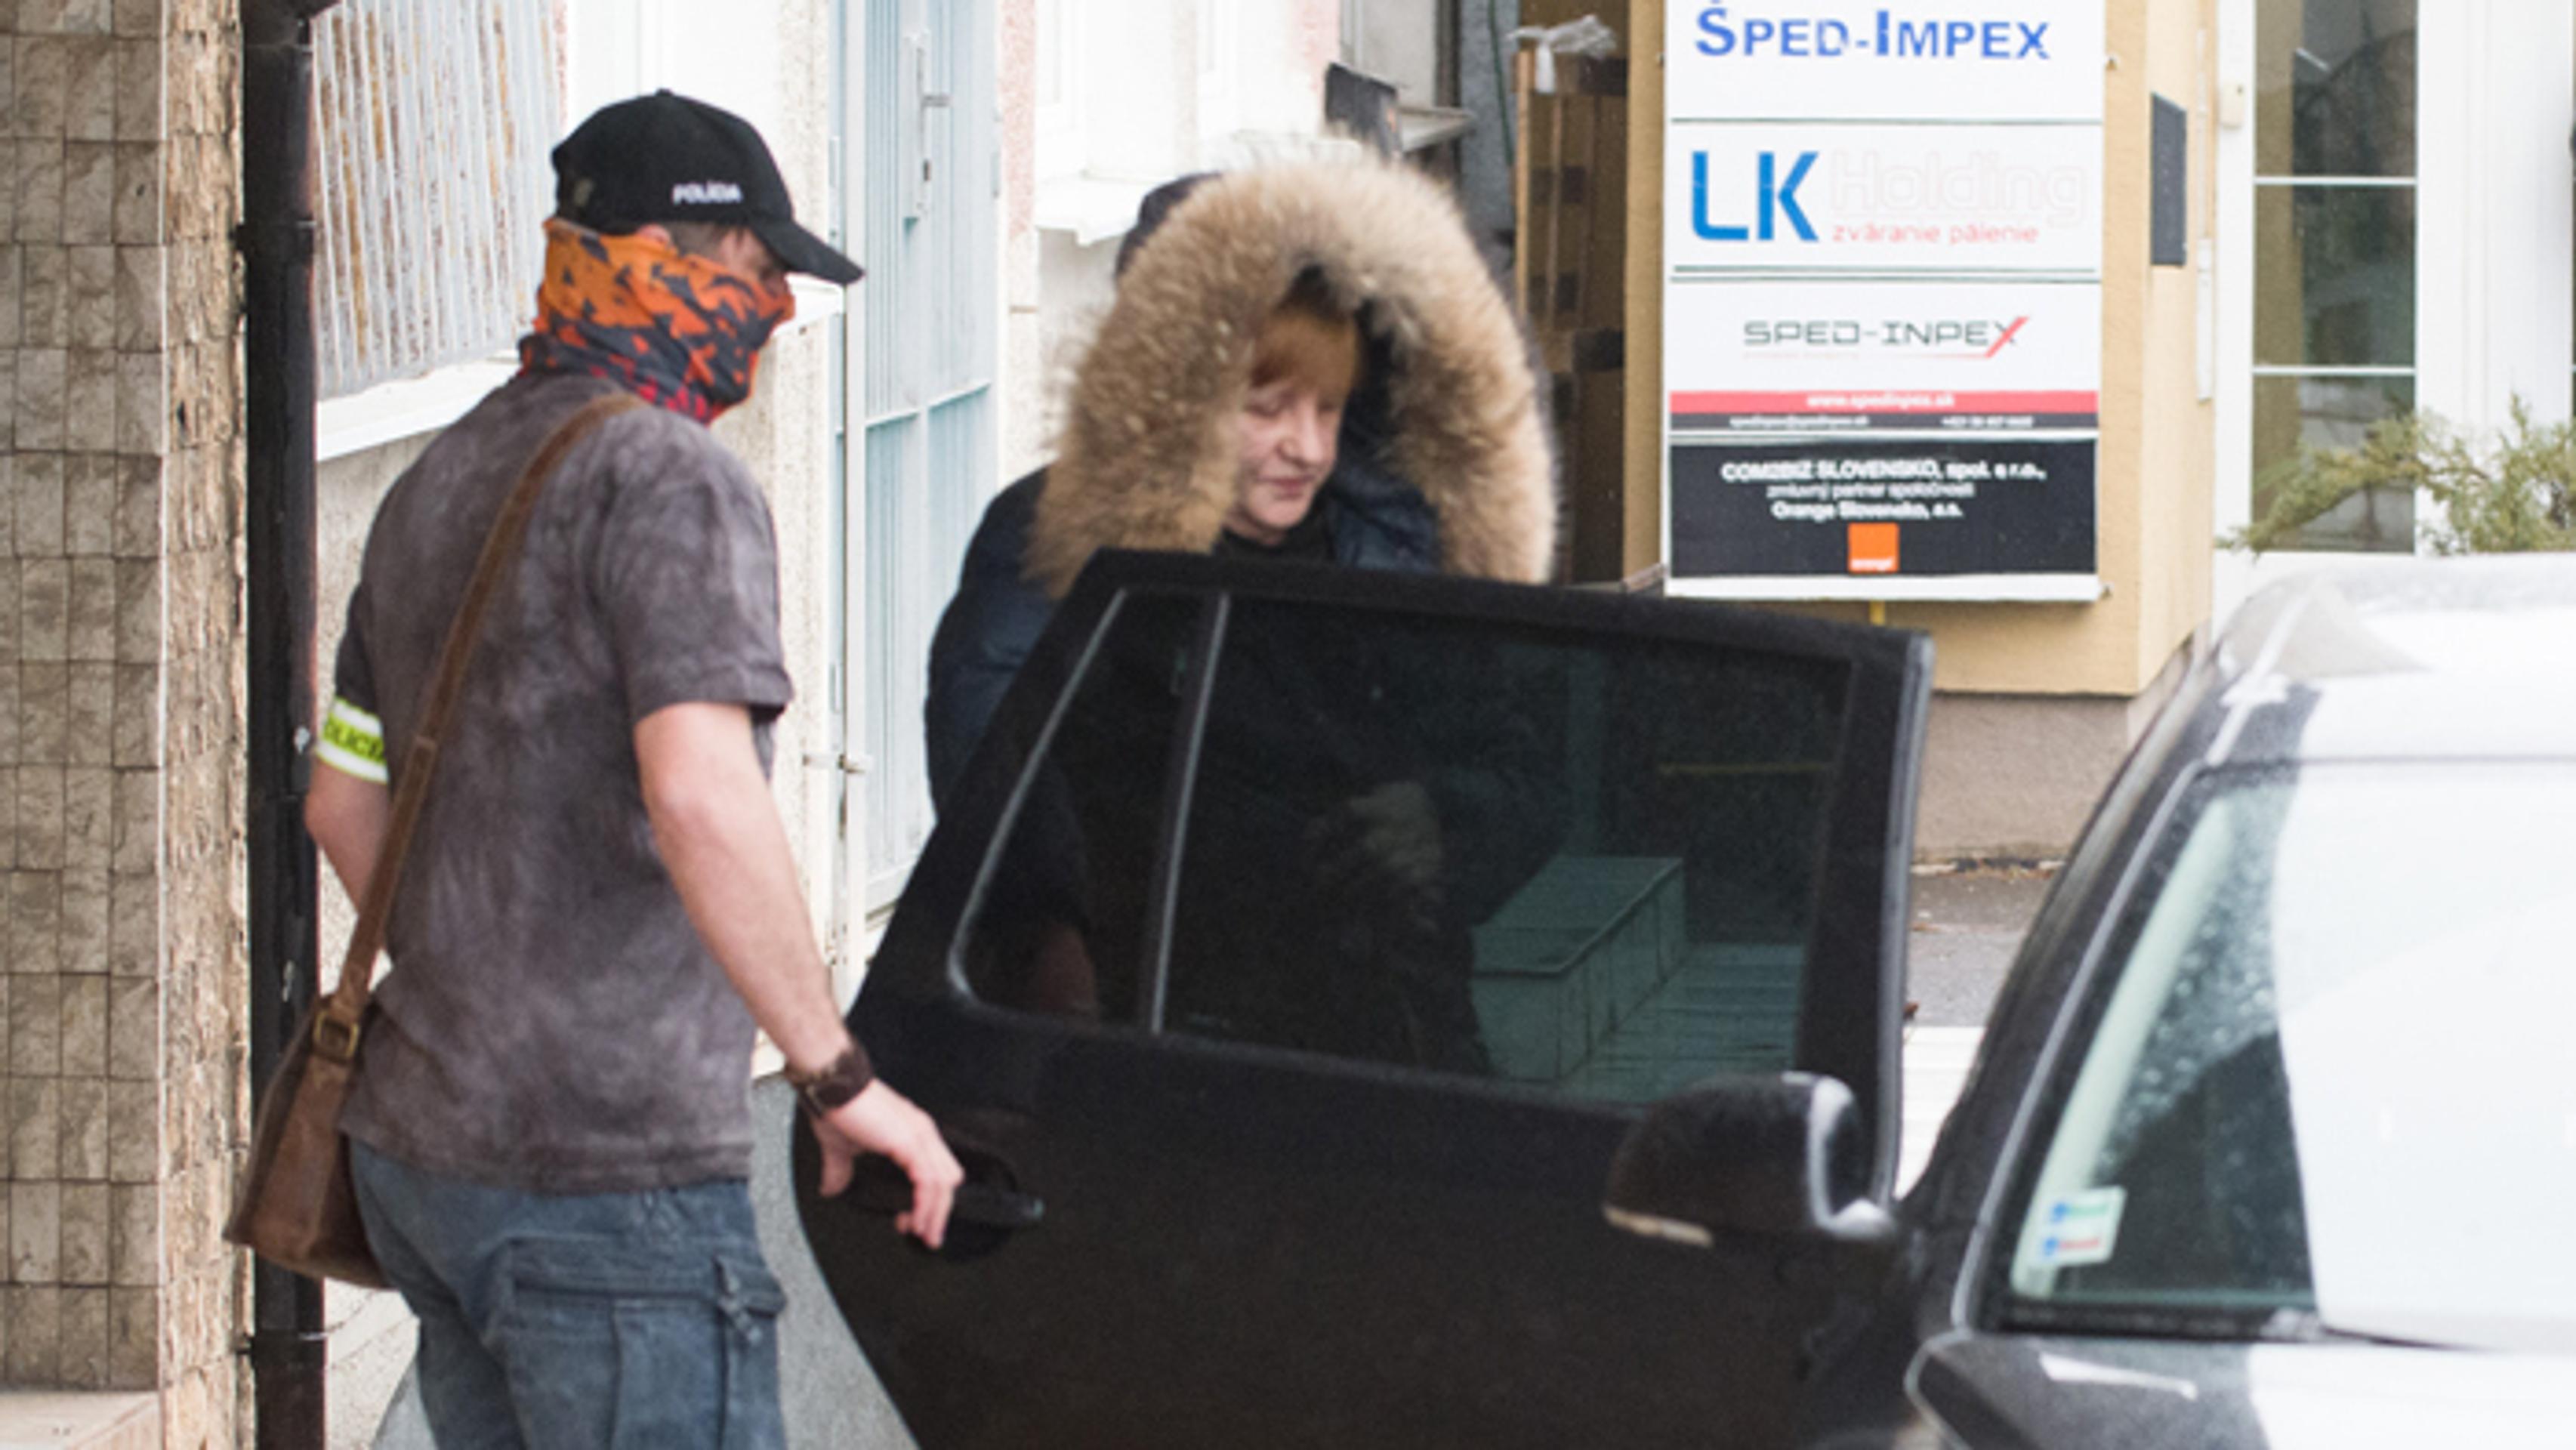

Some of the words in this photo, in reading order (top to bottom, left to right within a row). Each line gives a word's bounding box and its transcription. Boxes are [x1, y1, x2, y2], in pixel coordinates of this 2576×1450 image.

[1695, 0, 2050, 59] ŠPED-IMPEX
[1691, 150, 1819, 242] LK
[1831, 148, 2089, 227] Holding
[1831, 219, 1941, 243] zváranie
[1948, 219, 2039, 246] pálenie
[1743, 316, 2028, 358] SPED-INPEX
[1817, 459, 1942, 480] SLOVENSKO,
[1771, 500, 1835, 522] Orange
